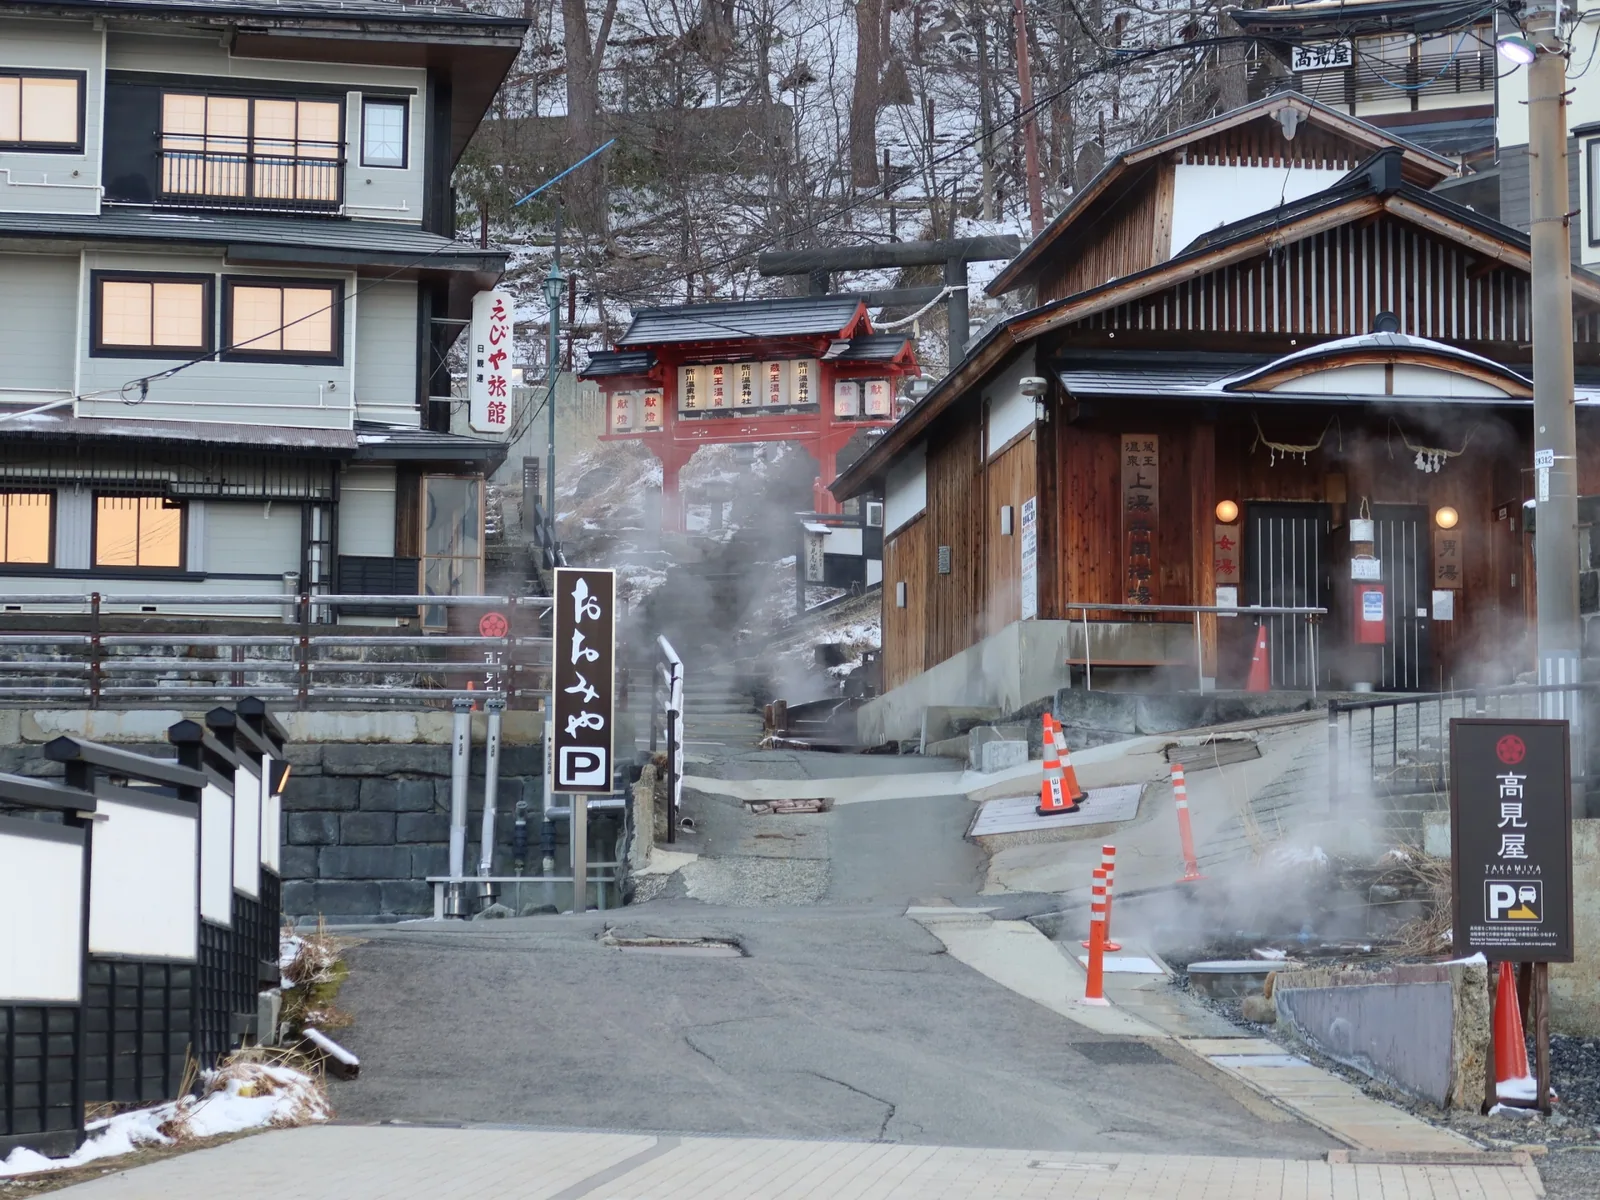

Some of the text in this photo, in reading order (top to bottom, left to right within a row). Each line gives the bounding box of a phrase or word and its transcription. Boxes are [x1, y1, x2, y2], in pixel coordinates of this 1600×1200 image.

[476, 345, 484, 383] 日観連
[487, 299, 509, 424] えびや旅館
[713, 366, 723, 407] 蔵王温泉
[770, 363, 780, 403] 蔵王温泉
[1215, 535, 1236, 575] 女湯
[1438, 539, 1458, 581] 男湯
[564, 577, 605, 739] おおみや
[566, 751, 601, 781] P
[1052, 779, 1061, 805] 山形市
[1495, 771, 1529, 859] 高見屋
[1490, 884, 1516, 919] P
